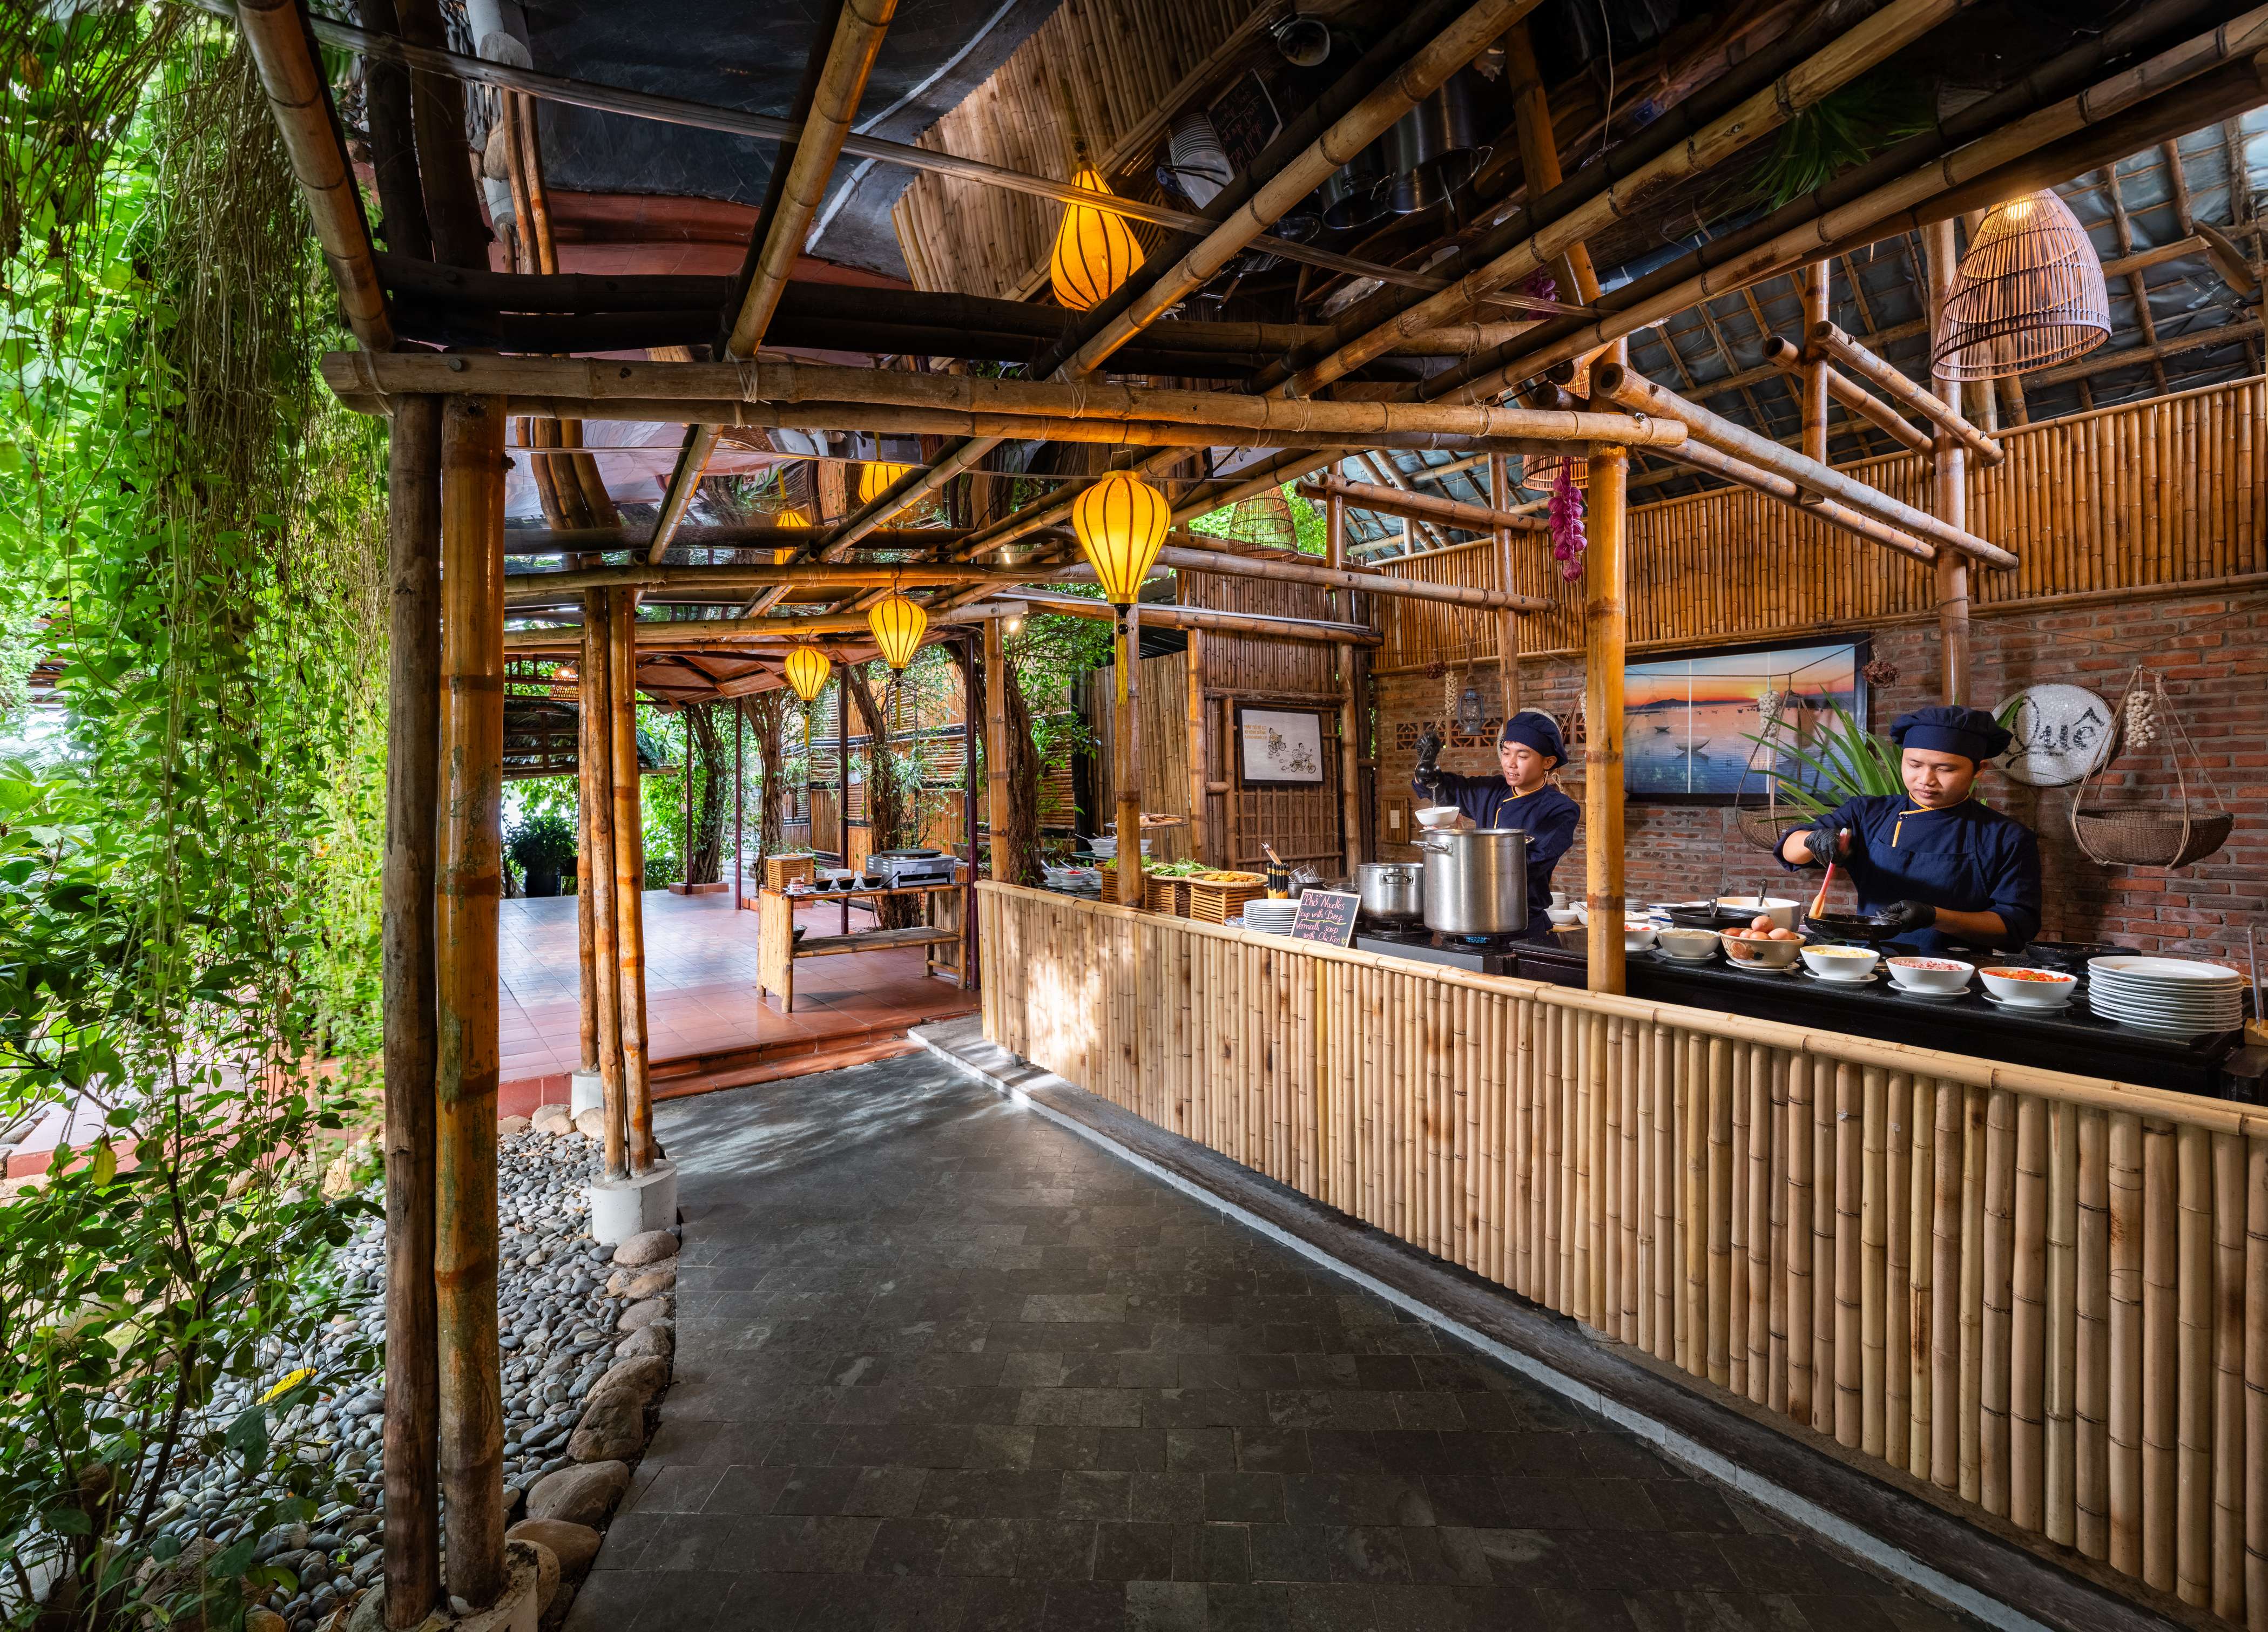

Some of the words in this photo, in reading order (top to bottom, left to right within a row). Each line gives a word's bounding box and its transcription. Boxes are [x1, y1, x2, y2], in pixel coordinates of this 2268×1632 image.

[1320, 895, 1346, 911] Noodles
[1298, 908, 1310, 920] Soup
[1312, 909, 1323, 918] with
[1325, 909, 1345, 924] Beef
[1295, 919, 1320, 931] Vermicelli
[1324, 925, 1338, 934] soup
[1303, 931, 1315, 940] with
